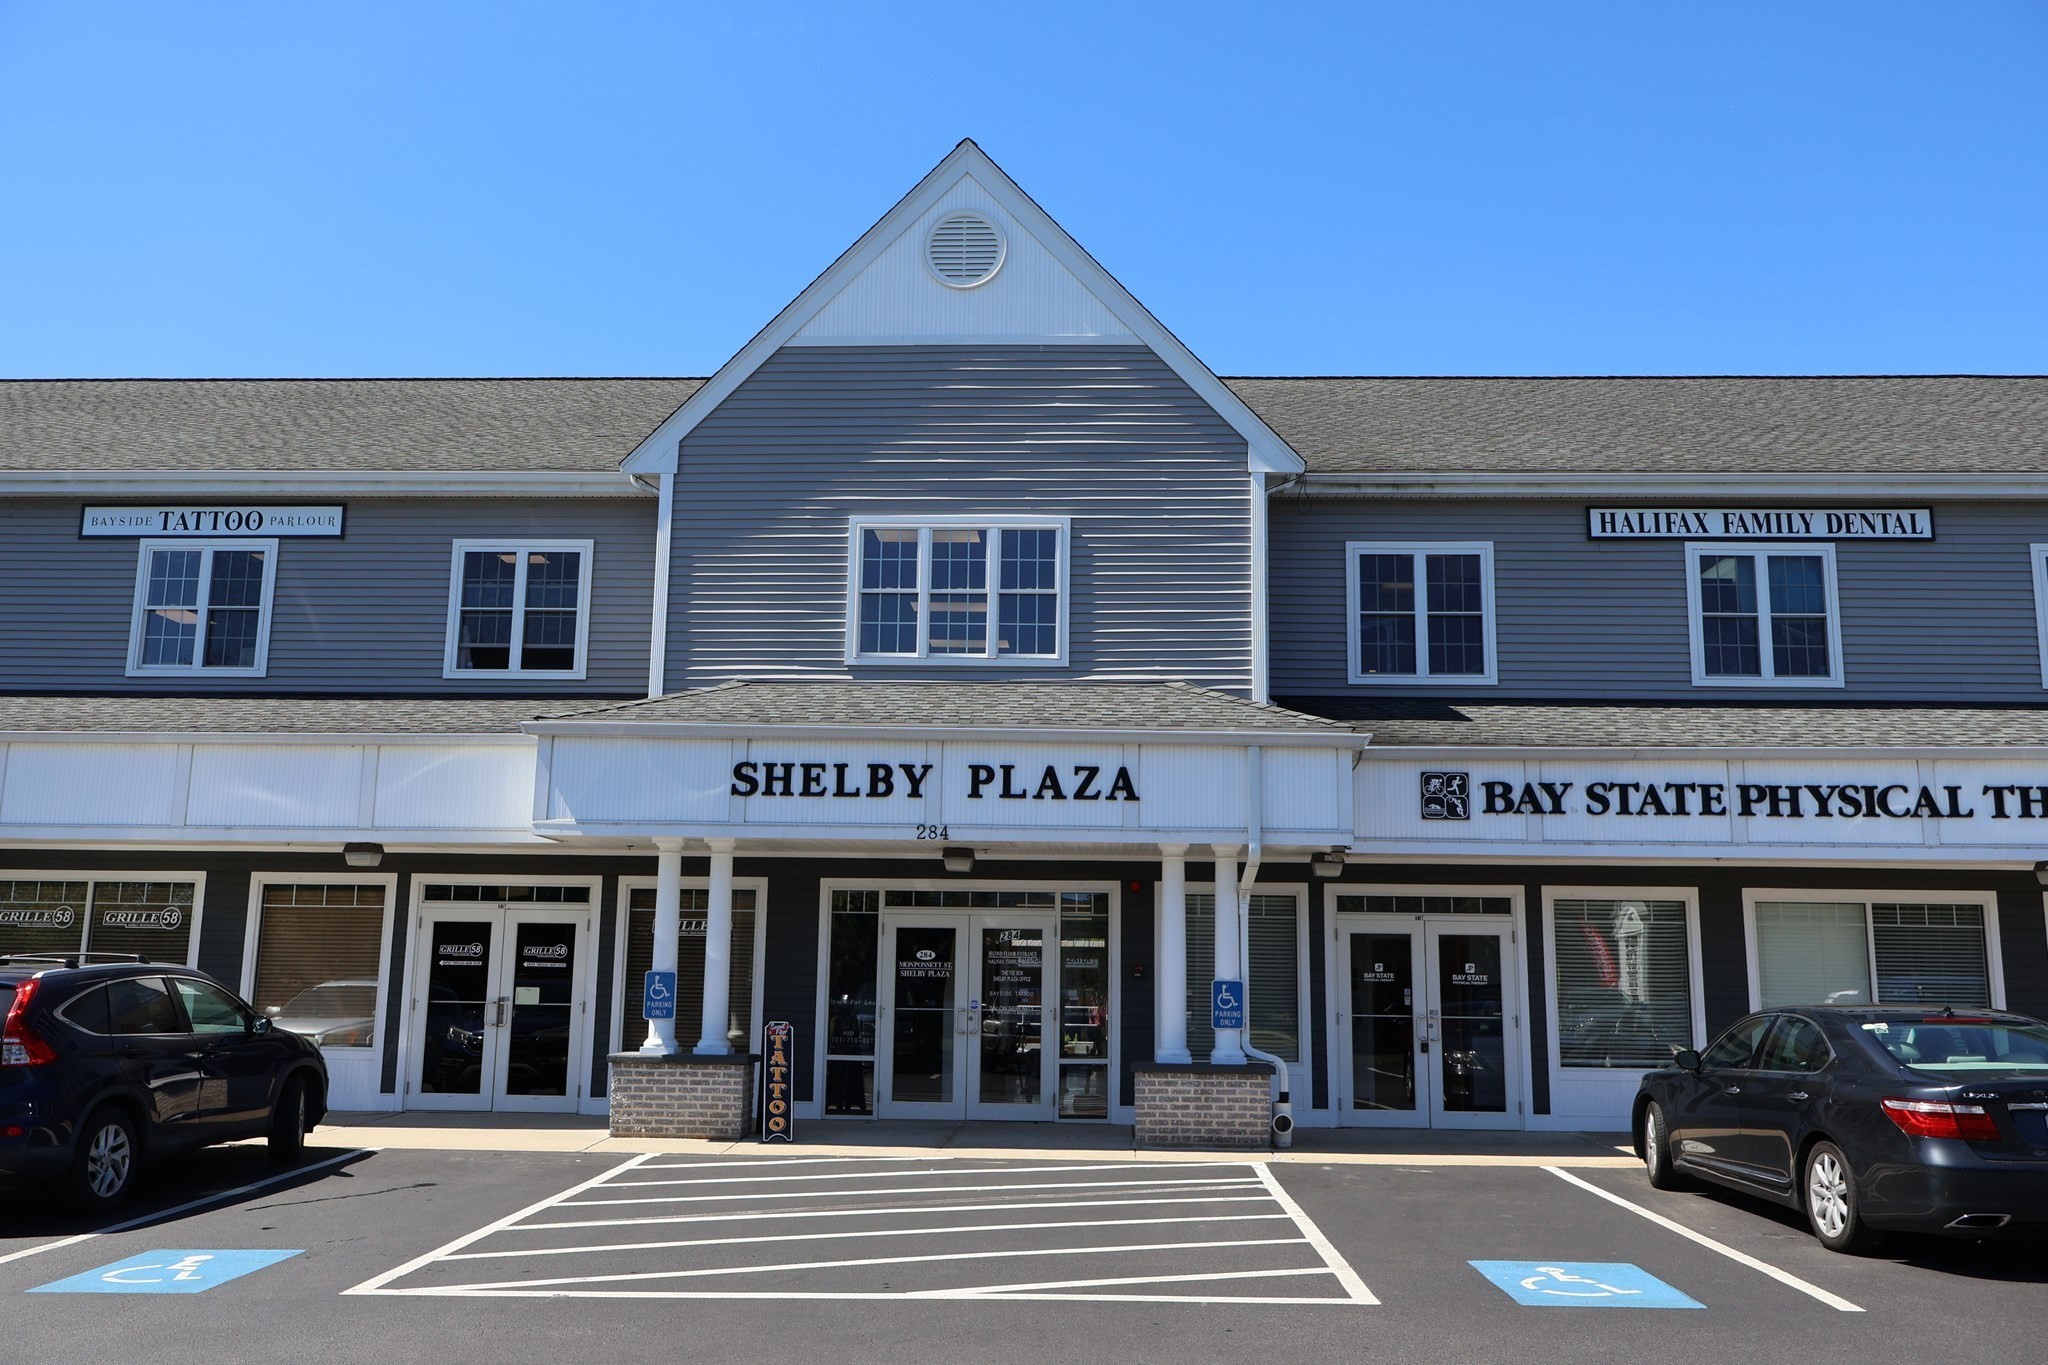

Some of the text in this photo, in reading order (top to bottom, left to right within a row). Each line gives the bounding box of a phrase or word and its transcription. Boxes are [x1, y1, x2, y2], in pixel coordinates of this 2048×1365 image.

[91, 510, 336, 531] BAYSIDE TATTOO PARLOUR
[1598, 511, 1924, 535] HALIFAX FAMILY DENTAL
[731, 761, 1141, 801] SHELBY PLAZA
[1481, 781, 1573, 816] BAY
[1585, 782, 1727, 818] STATE
[1737, 783, 1974, 819] PHYSICAL
[916, 825, 949, 841] 284
[55, 910, 71, 923] 58
[105, 912, 179, 924] GRILLE 58
[1001, 931, 1020, 941] 284
[441, 945, 481, 954] GRILLE 58
[555, 947, 566, 955] 58
[919, 951, 932, 959] 284
[928, 970, 951, 978] PLAZA
[651, 1009, 667, 1017] ONLY
[1215, 1010, 1241, 1018] PARKING
[769, 1035, 789, 1132] TATTOO
